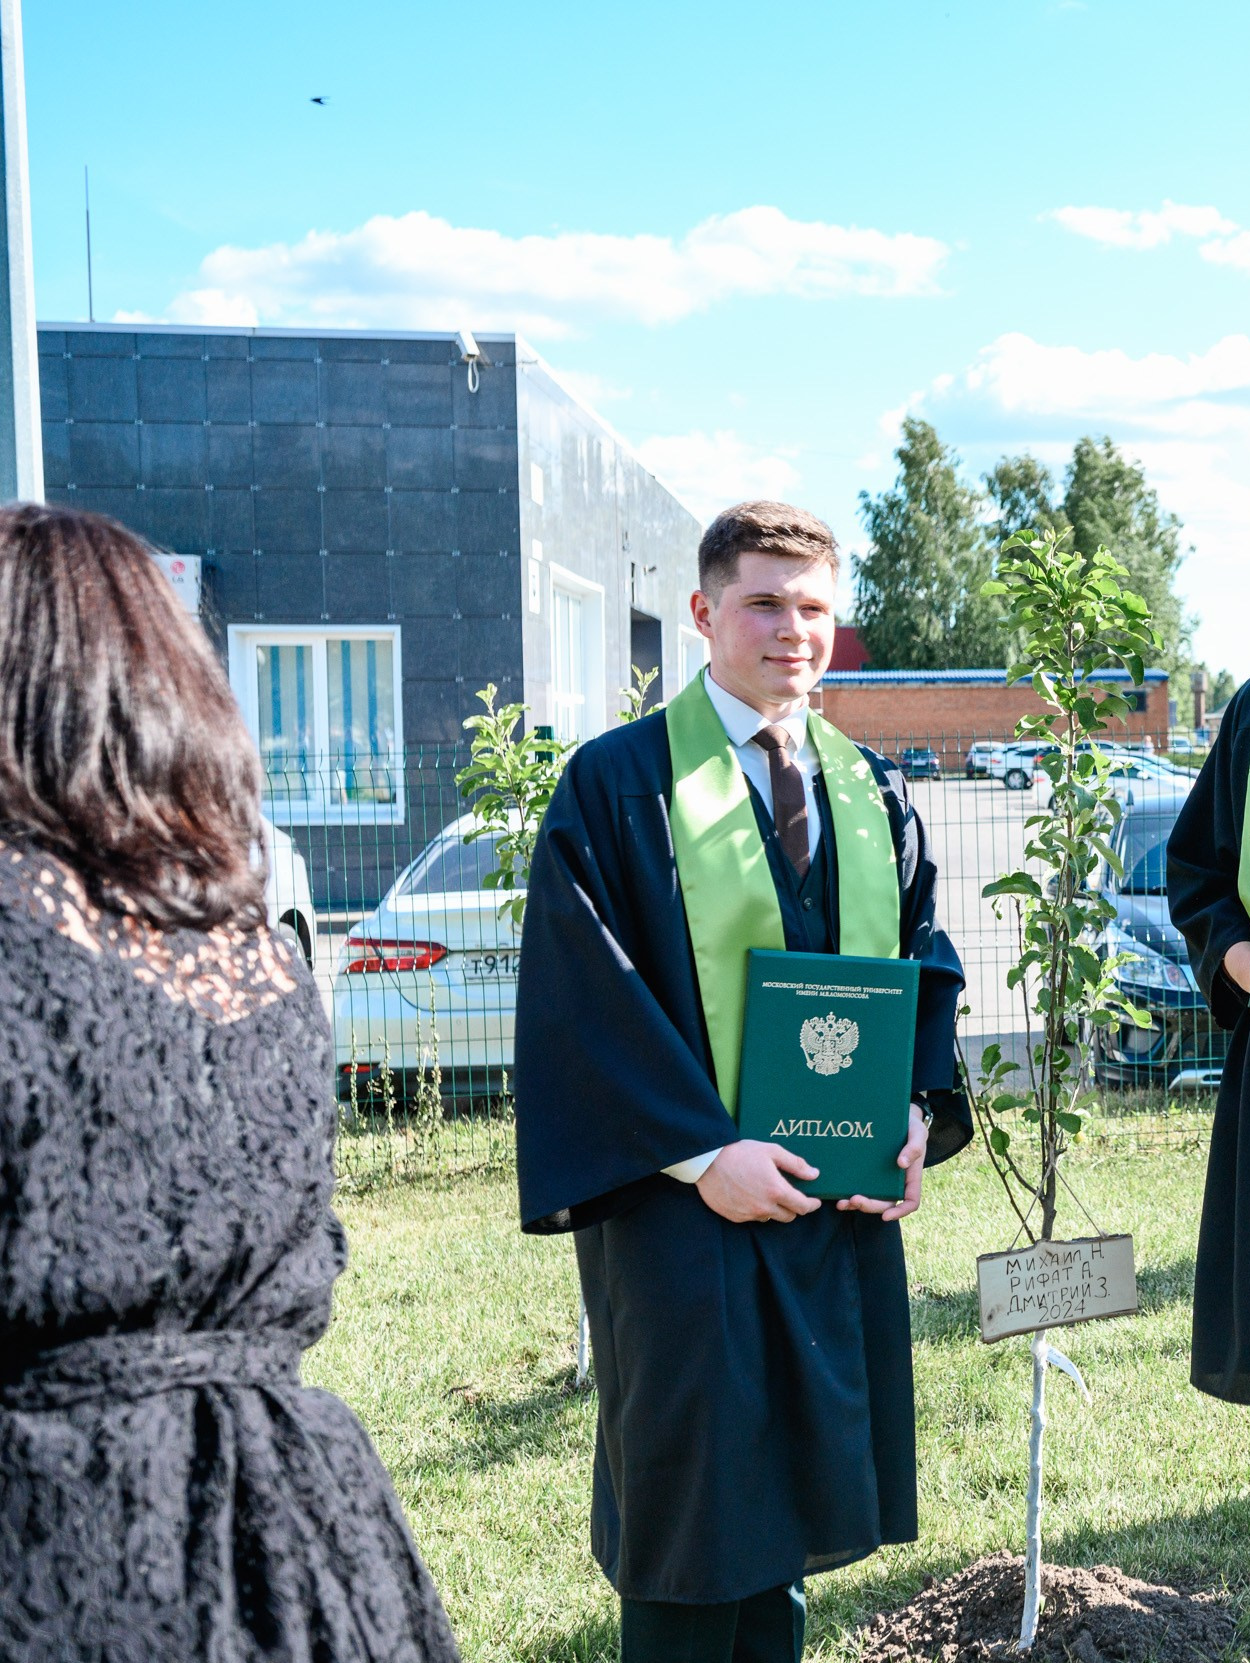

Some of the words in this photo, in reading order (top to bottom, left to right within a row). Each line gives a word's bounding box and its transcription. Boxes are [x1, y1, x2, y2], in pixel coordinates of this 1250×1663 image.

[762, 981, 804, 989] МОСКОВСКИЙ
[805, 984, 862, 993] ГОСУДАРСТВЕННЫЙ
[863, 987, 903, 995] УНИВЕРСИТЕТ
[770, 1119, 874, 1138] ДИПЛОМ
[1006, 1249, 1082, 1275] МИХАИЛ
[1010, 1266, 1073, 1293] РИФАТ
[1007, 1281, 1091, 1315] ДМИТРИЙ
[1038, 1299, 1086, 1323] 2024
